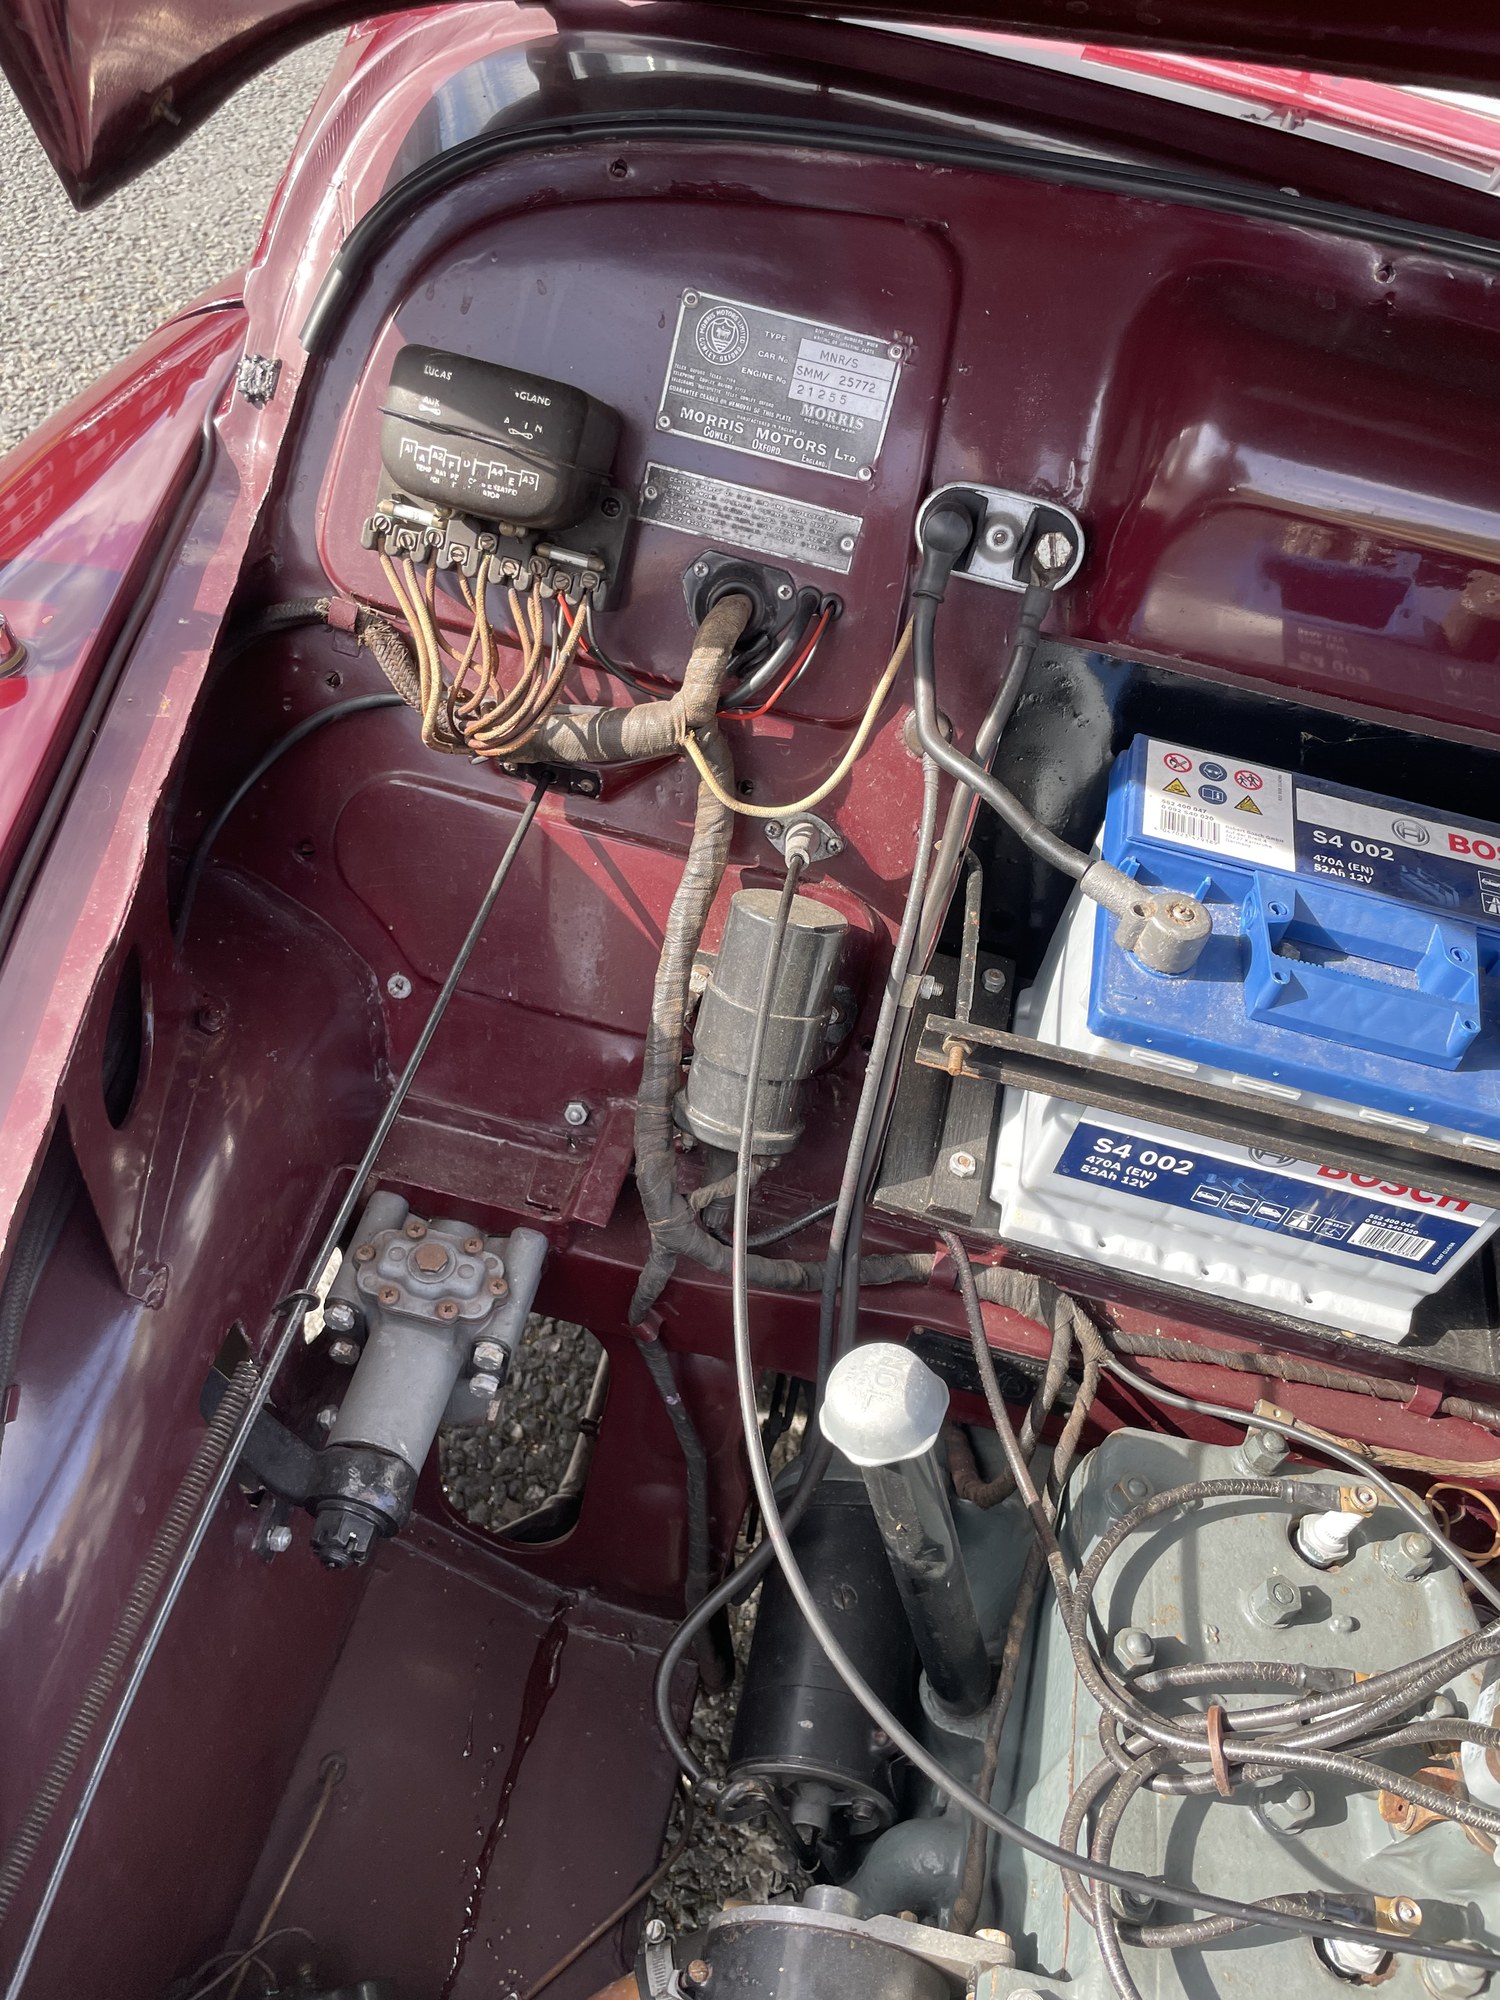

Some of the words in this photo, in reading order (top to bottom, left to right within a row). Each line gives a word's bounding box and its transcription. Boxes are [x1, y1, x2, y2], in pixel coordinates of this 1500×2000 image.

[700, 312, 715, 334] MORRIS
[716, 310, 739, 321] MOTORS
[737, 320, 746, 343] LIMITED
[764, 331, 787, 342] TYPE
[757, 350, 776, 361] CAR
[820, 350, 859, 369] MNR/S
[424, 364, 452, 380] LUCAS
[741, 366, 774, 381] ENGINE
[796, 365, 830, 381] SMM/
[839, 375, 876, 393] 25772
[422, 396, 440, 407] AUX
[669, 384, 698, 397] GUARANTEE
[699, 392, 719, 402] CEASES
[728, 400, 752, 411] REMOVAL
[762, 409, 774, 418] THIS
[796, 384, 847, 405] 21255
[801, 403, 864, 430] MORRIS
[680, 407, 744, 434] MORRIS
[756, 427, 827, 456] MOTORS
[419, 454, 425, 462] A
[432, 452, 444, 460] A2
[491, 468, 503, 477] A4
[509, 477, 515, 486] E
[522, 476, 535, 485] A3
[1312, 830, 1344, 849] S4
[1350, 840, 1395, 862] 002
[1312, 854, 1345, 868] 470A
[1347, 862, 1374, 876] (EN)
[1313, 863, 1346, 878] 52Ah
[1349, 872, 1373, 884] 12V
[1093, 1138, 1133, 1159] S4
[1140, 1151, 1194, 1176] 002
[1080, 1164, 1118, 1181] 52Ah
[1120, 1176, 1150, 1189] 12V
[1085, 1155, 1121, 1172] 470A
[1125, 1166, 1158, 1182] (EN)
[1384, 1217, 1400, 1225] 400
